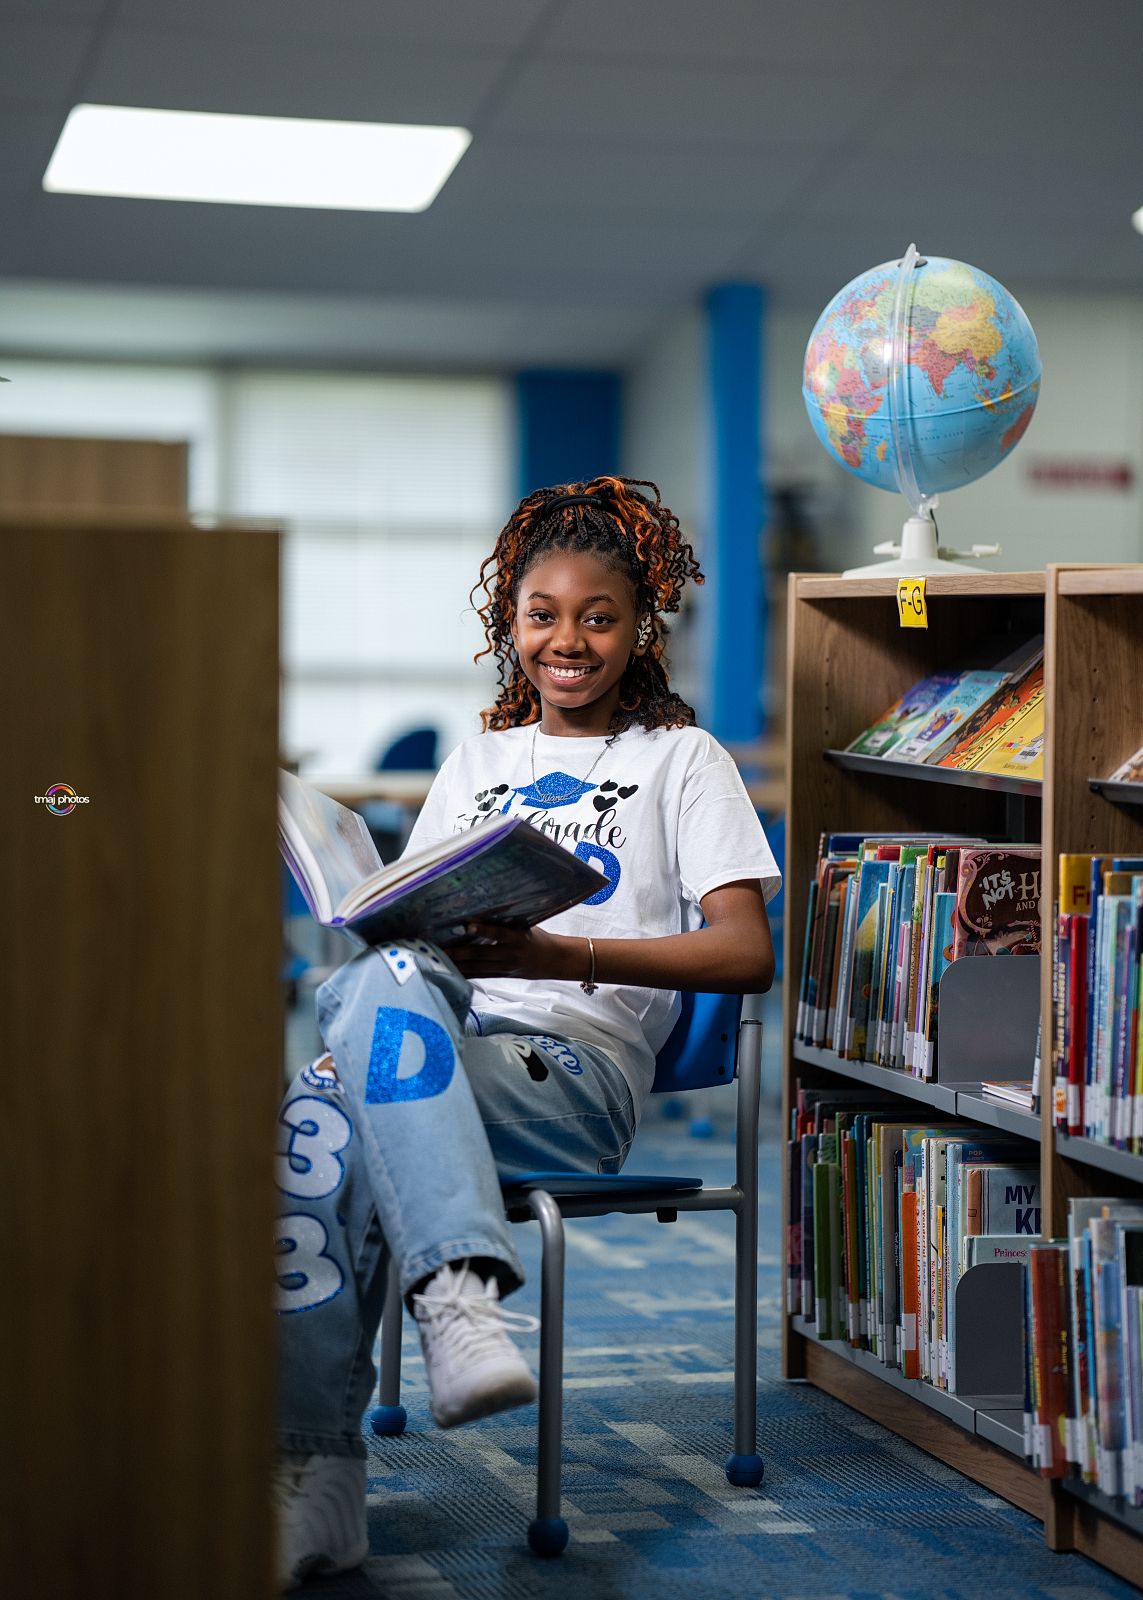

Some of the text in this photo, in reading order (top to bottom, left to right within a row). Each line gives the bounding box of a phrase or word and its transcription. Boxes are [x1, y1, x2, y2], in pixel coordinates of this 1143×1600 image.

[899, 585, 924, 616] F-G
[982, 869, 1012, 891] IT'S
[982, 881, 1016, 911] NOT
[1015, 900, 1036, 912] AND
[365, 1005, 456, 1105] D
[1004, 1184, 1036, 1205] MY
